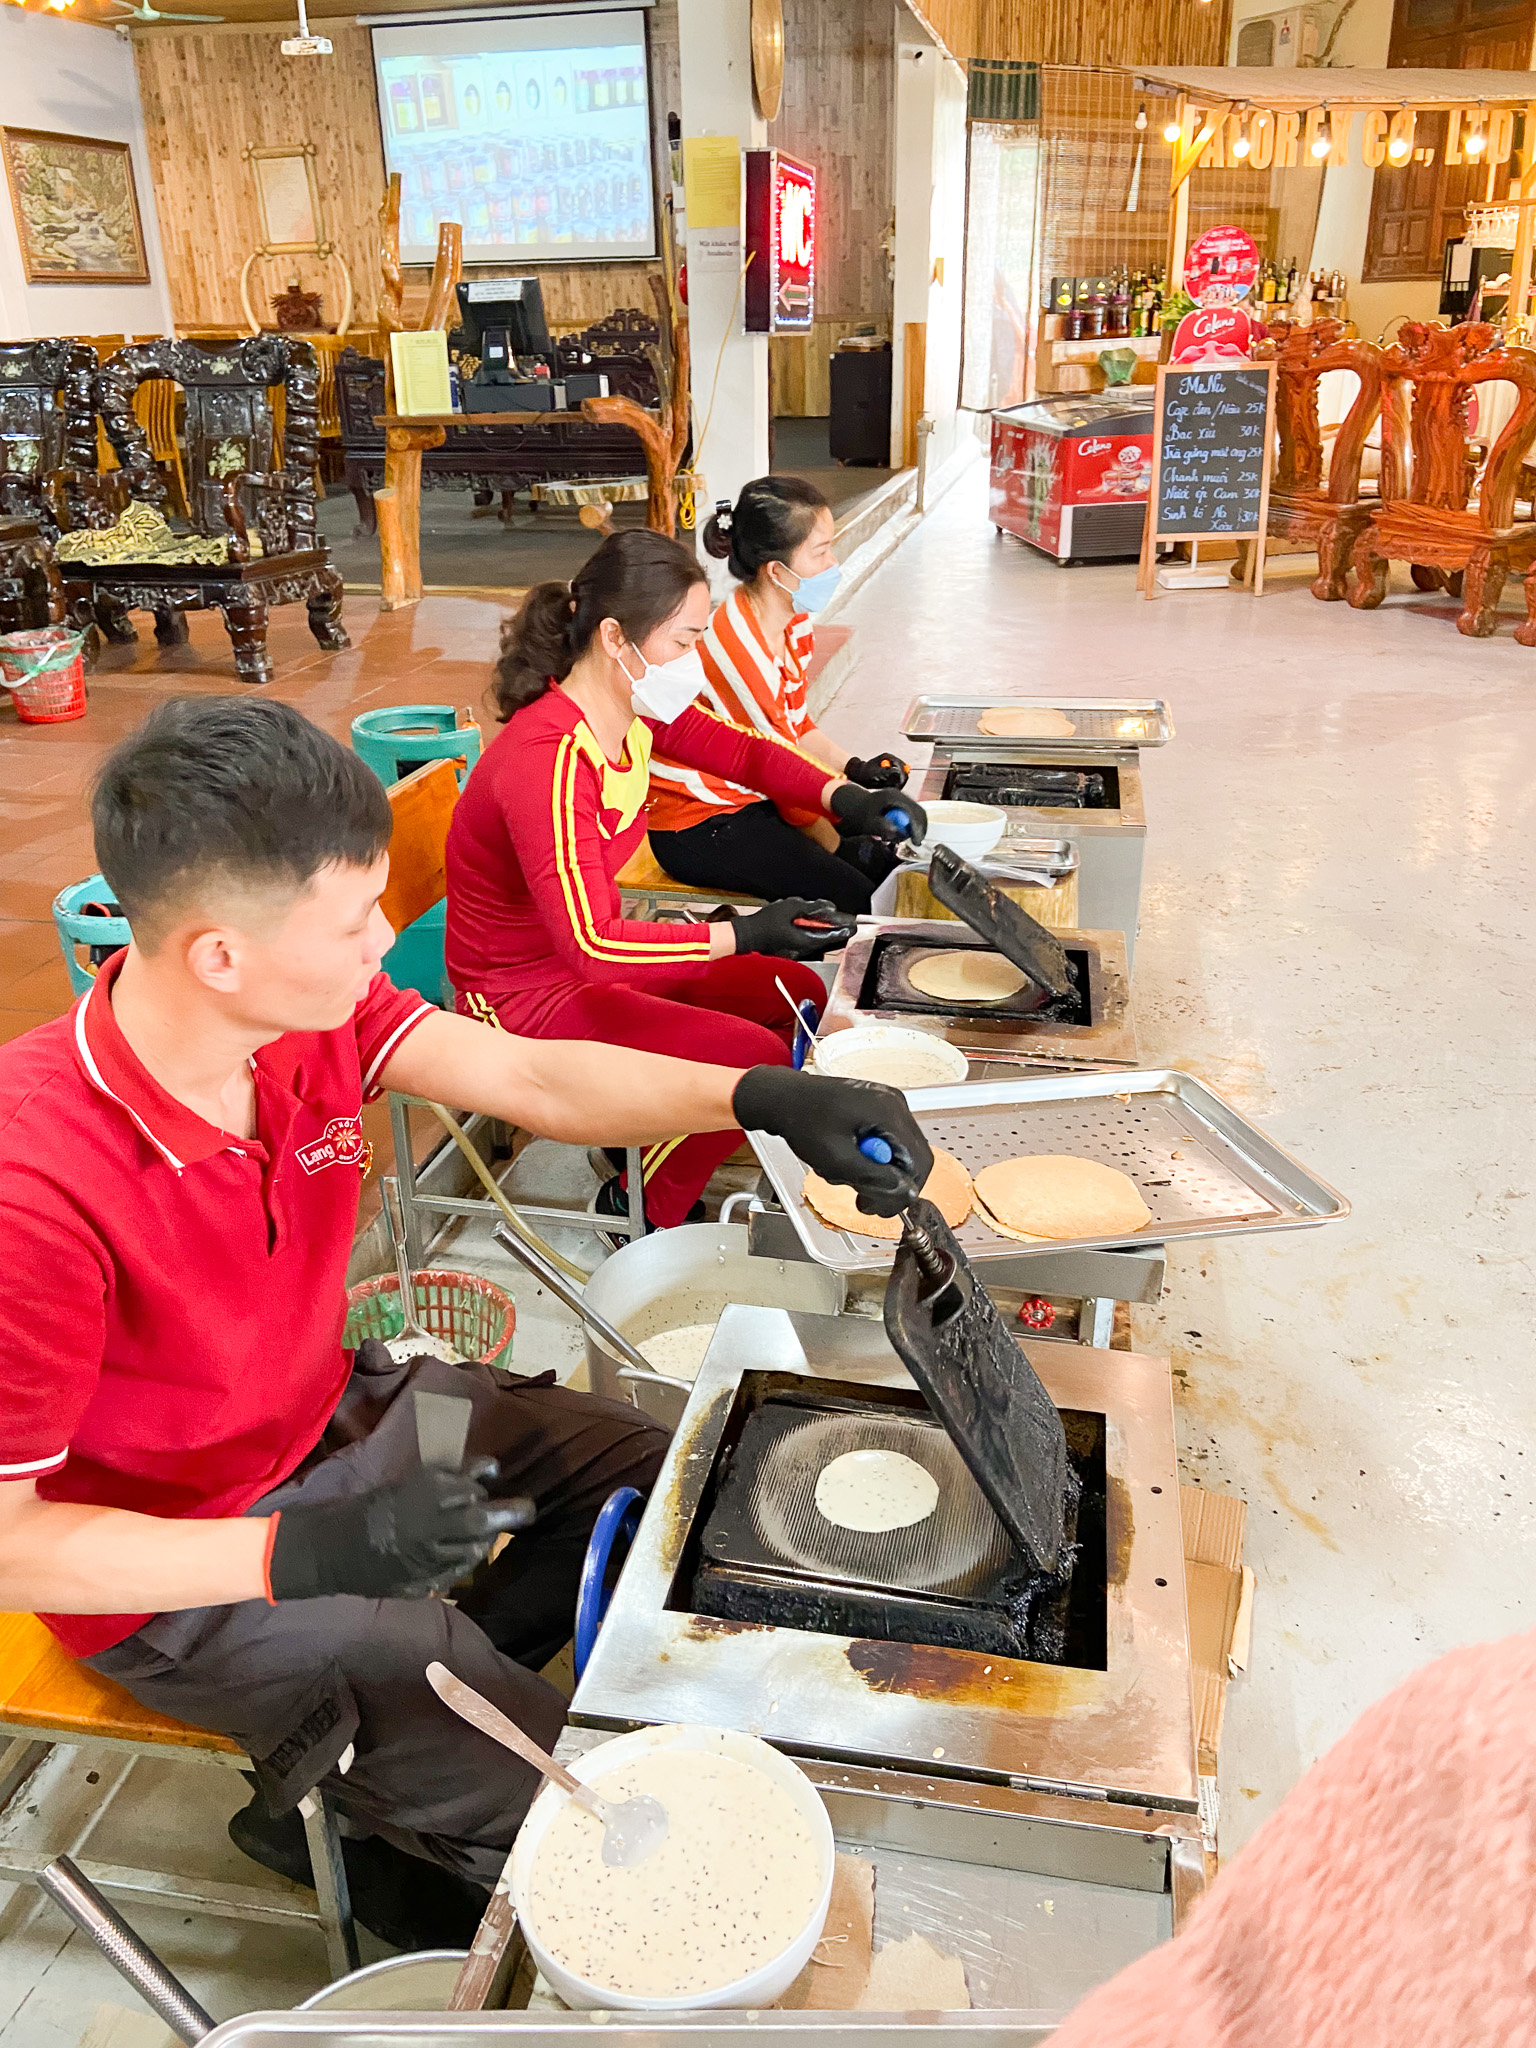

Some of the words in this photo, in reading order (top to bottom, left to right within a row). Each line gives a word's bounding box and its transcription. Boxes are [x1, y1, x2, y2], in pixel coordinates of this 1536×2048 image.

[1363, 110, 1435, 168] CO.,
[1445, 109, 1513, 165] LTD
[1163, 466, 1198, 483] Chanh
[301, 1143, 335, 1166] Lạng
